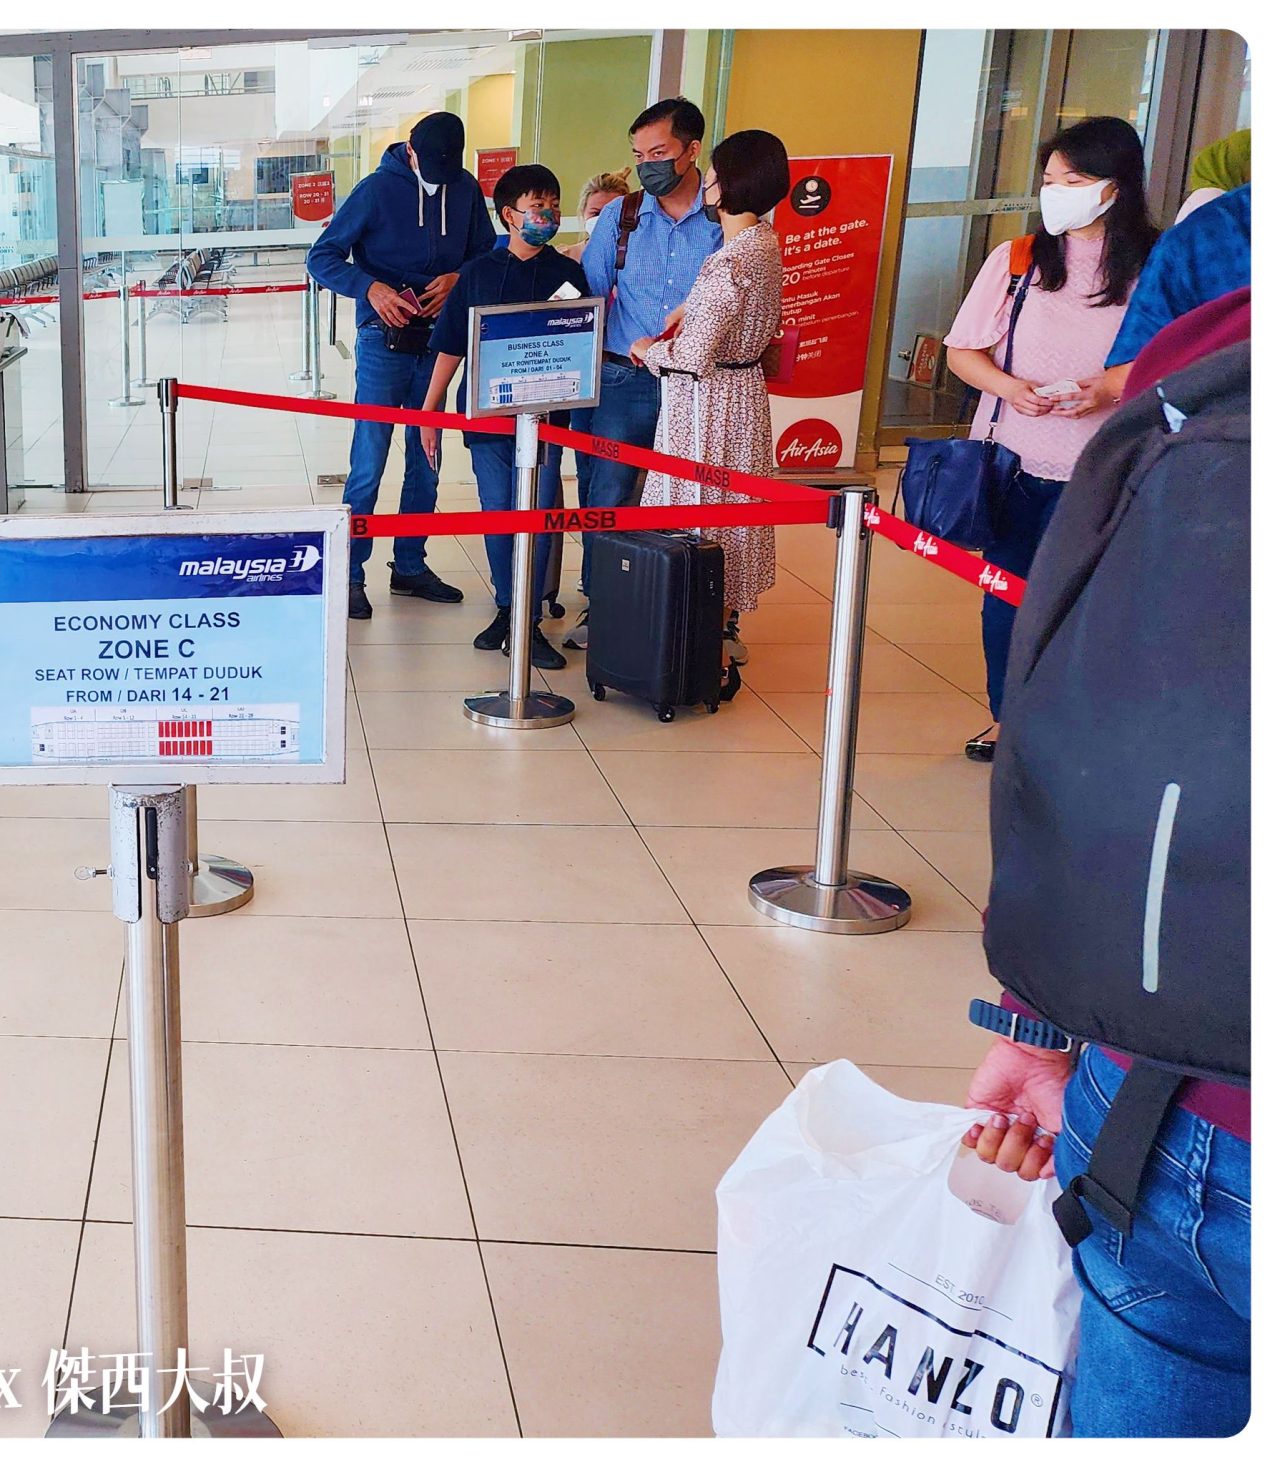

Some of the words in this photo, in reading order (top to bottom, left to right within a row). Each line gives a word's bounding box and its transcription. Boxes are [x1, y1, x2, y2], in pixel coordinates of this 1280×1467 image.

[785, 233, 801, 245] Be
[803, 230, 816, 241] at
[818, 225, 839, 238] the
[840, 218, 869, 234] gate.
[784, 245, 801, 257] It's
[813, 236, 843, 250] date.
[782, 261, 813, 273] Boarding
[814, 258, 830, 267] Gate
[831, 251, 855, 262] Closes
[781, 271, 801, 286] 20
[802, 266, 826, 276] minutes
[802, 273, 821, 281] before
[781, 296, 795, 304] intu
[797, 291, 819, 300] Masuk
[781, 297, 822, 310] enerbangan
[823, 292, 841, 301] Akan
[547, 317, 583, 328] malaysia
[798, 314, 816, 323] minit
[507, 341, 541, 351] BUSINESS
[542, 339, 565, 348] CLASS
[524, 351, 543, 359] ZONE
[592, 438, 620, 459] MASB
[781, 438, 839, 462] AirAsia
[694, 464, 731, 488] MASB
[544, 510, 617, 532] MASB
[179, 557, 287, 580] malaysia
[246, 573, 283, 582] airlines
[54, 614, 162, 632] ECONOMY
[169, 611, 241, 629] CLASS
[98, 639, 169, 660] ZONE
[178, 638, 195, 659] C
[34, 668, 77, 682] SEAT
[81, 668, 120, 681] ROW
[135, 666, 198, 681] TEMPAT
[203, 665, 263, 680] DUDUK
[66, 690, 113, 703] FROM
[127, 689, 166, 703] DARI
[172, 687, 193, 702] 14
[210, 686, 230, 702] 21
[833, 1301, 1025, 1434] HANZO
[879, 1386, 936, 1425] fashion
